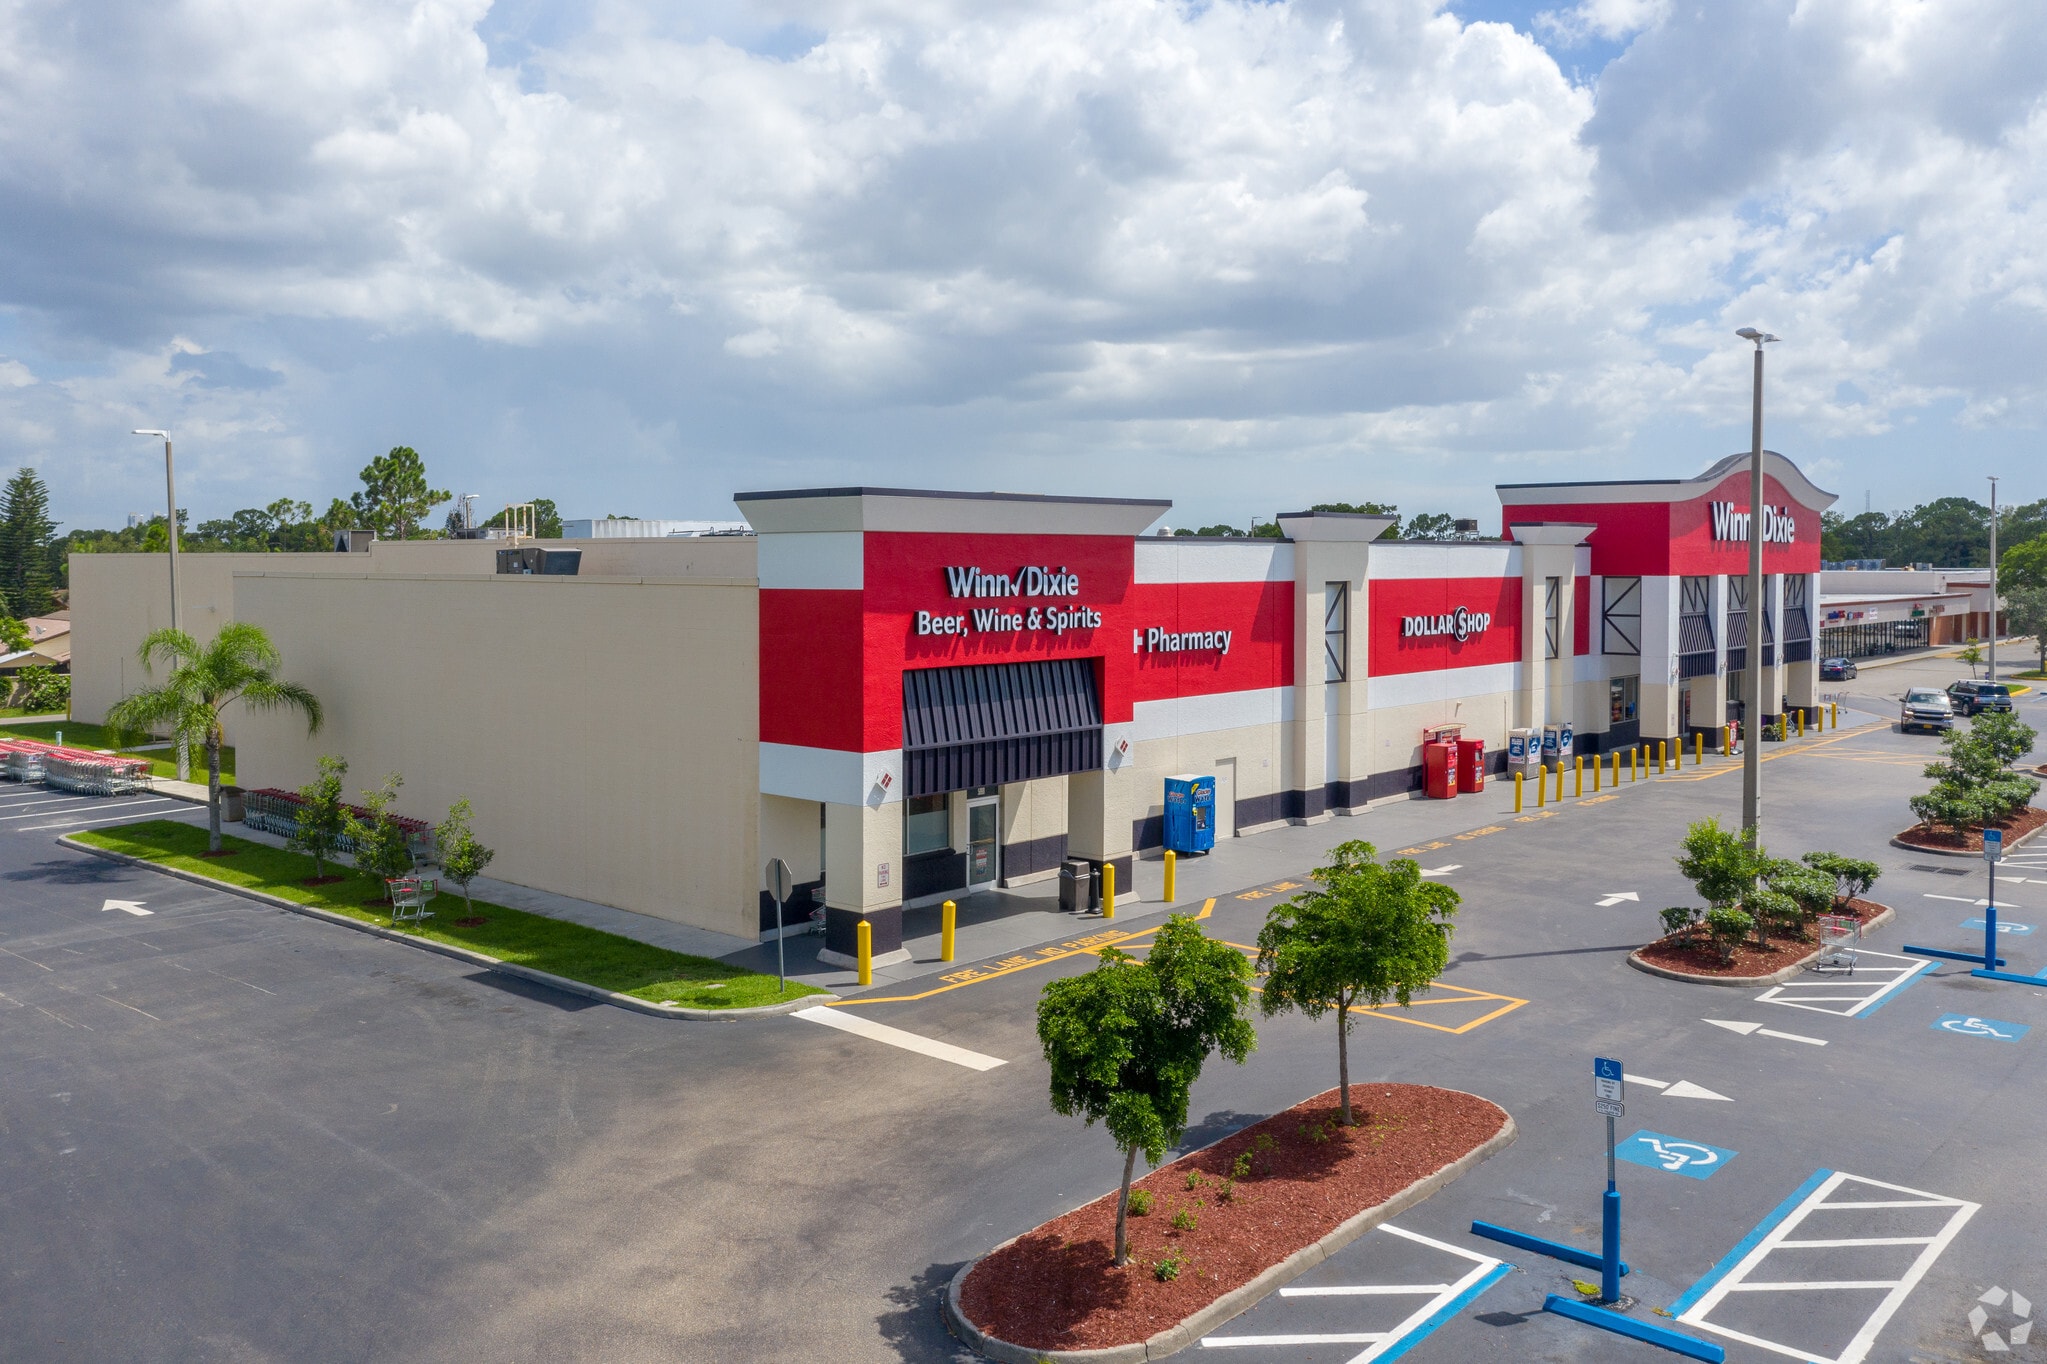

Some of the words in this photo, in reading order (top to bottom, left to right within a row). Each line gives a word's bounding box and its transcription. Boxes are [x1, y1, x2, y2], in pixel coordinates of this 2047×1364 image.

[1762, 505, 1795, 543] Dixie
[946, 566, 1010, 597] Winn
[1027, 566, 1079, 597] Dixie
[917, 611, 968, 637] Beer,
[973, 608, 1023, 632] Wine
[1027, 607, 1042, 630] &
[1046, 605, 1102, 635] Spirits
[1405, 614, 1454, 637] DOLLAR
[1148, 626, 1232, 655] Pharmacy
[938, 968, 988, 984] FIRE
[983, 955, 1037, 971] LANE
[1035, 947, 1068, 957] NO
[1061, 929, 1131, 950] PARKING
